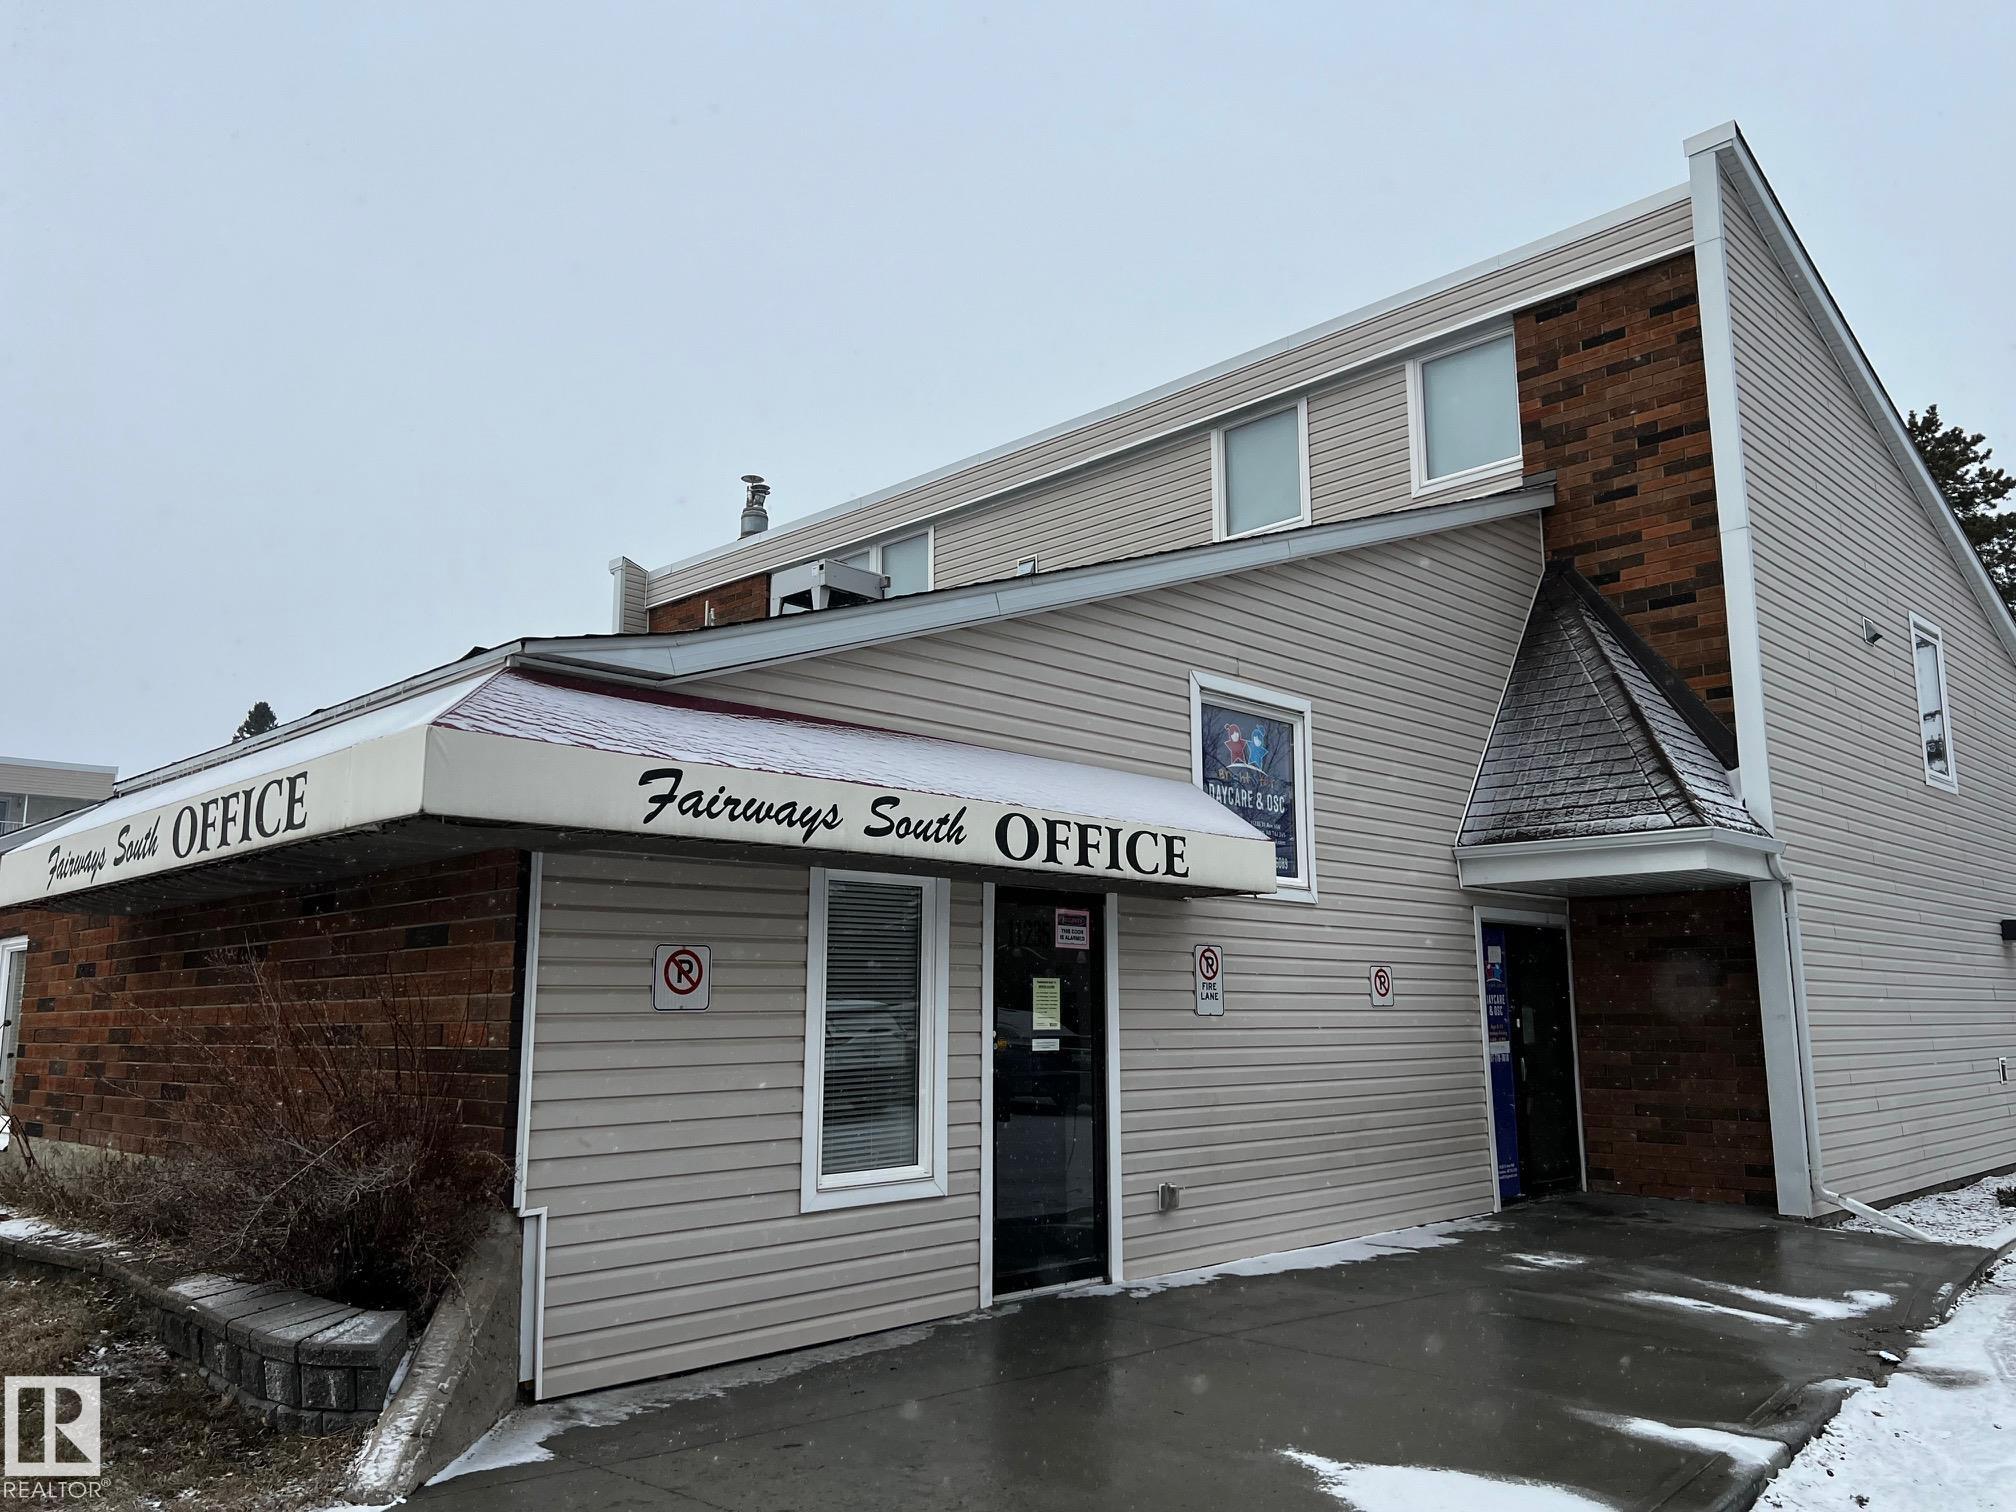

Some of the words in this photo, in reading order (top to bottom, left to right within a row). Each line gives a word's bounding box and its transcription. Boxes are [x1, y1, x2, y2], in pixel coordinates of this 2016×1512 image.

[1208, 783, 1254, 809] DAYCARE
[1256, 792, 1265, 811] &
[1267, 794, 1285, 814] OSC
[47, 845, 106, 890] Fairways
[113, 815, 161, 867] South
[172, 771, 308, 859] OFFICE
[638, 767, 843, 843] Fairways
[864, 796, 967, 846] South
[994, 812, 1190, 878] OFFICE
[1201, 992, 1219, 1000] LANE
[1202, 982, 1217, 990] FIRE
